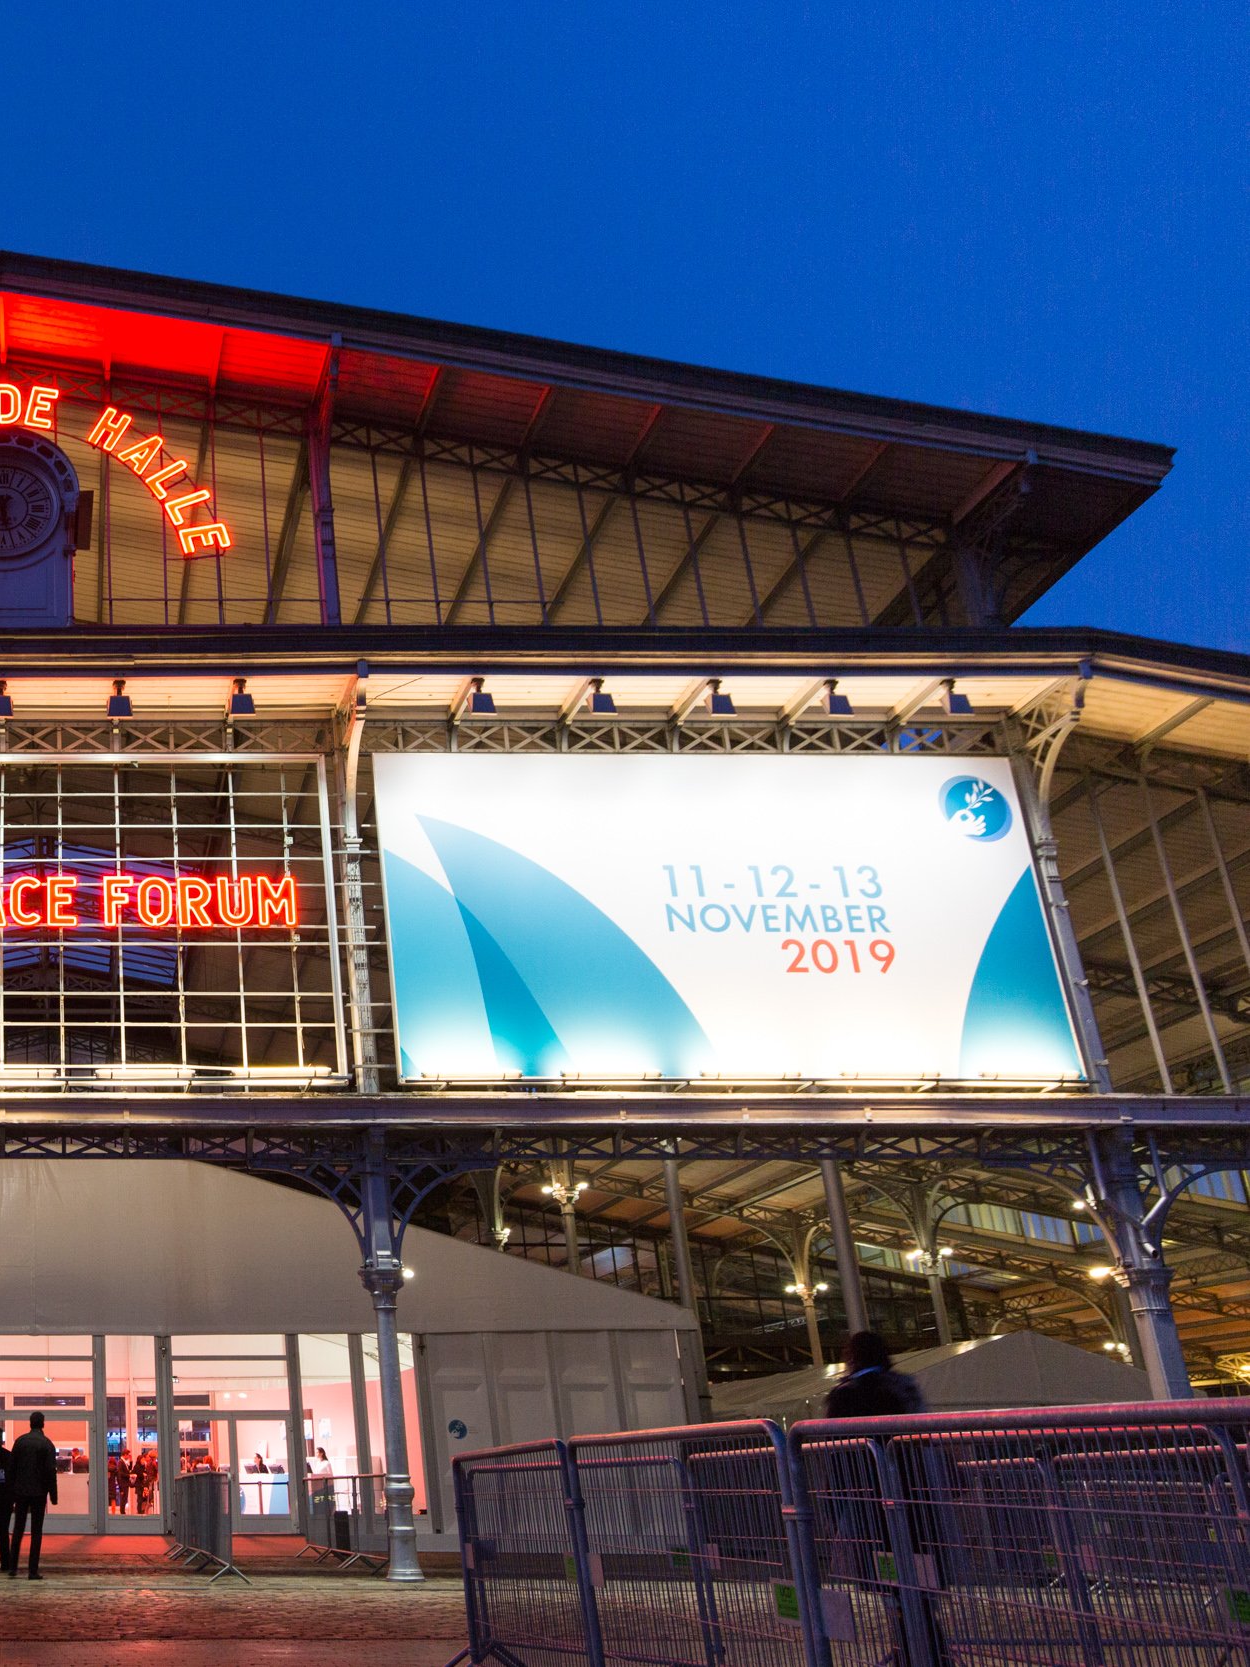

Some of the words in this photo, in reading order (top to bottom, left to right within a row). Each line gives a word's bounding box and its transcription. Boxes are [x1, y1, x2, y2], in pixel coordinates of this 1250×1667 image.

[88, 406, 232, 556] HALLE
[102, 875, 298, 927] FORUM
[664, 903, 892, 933] NOVEMBER
[781, 938, 896, 974] 2019
